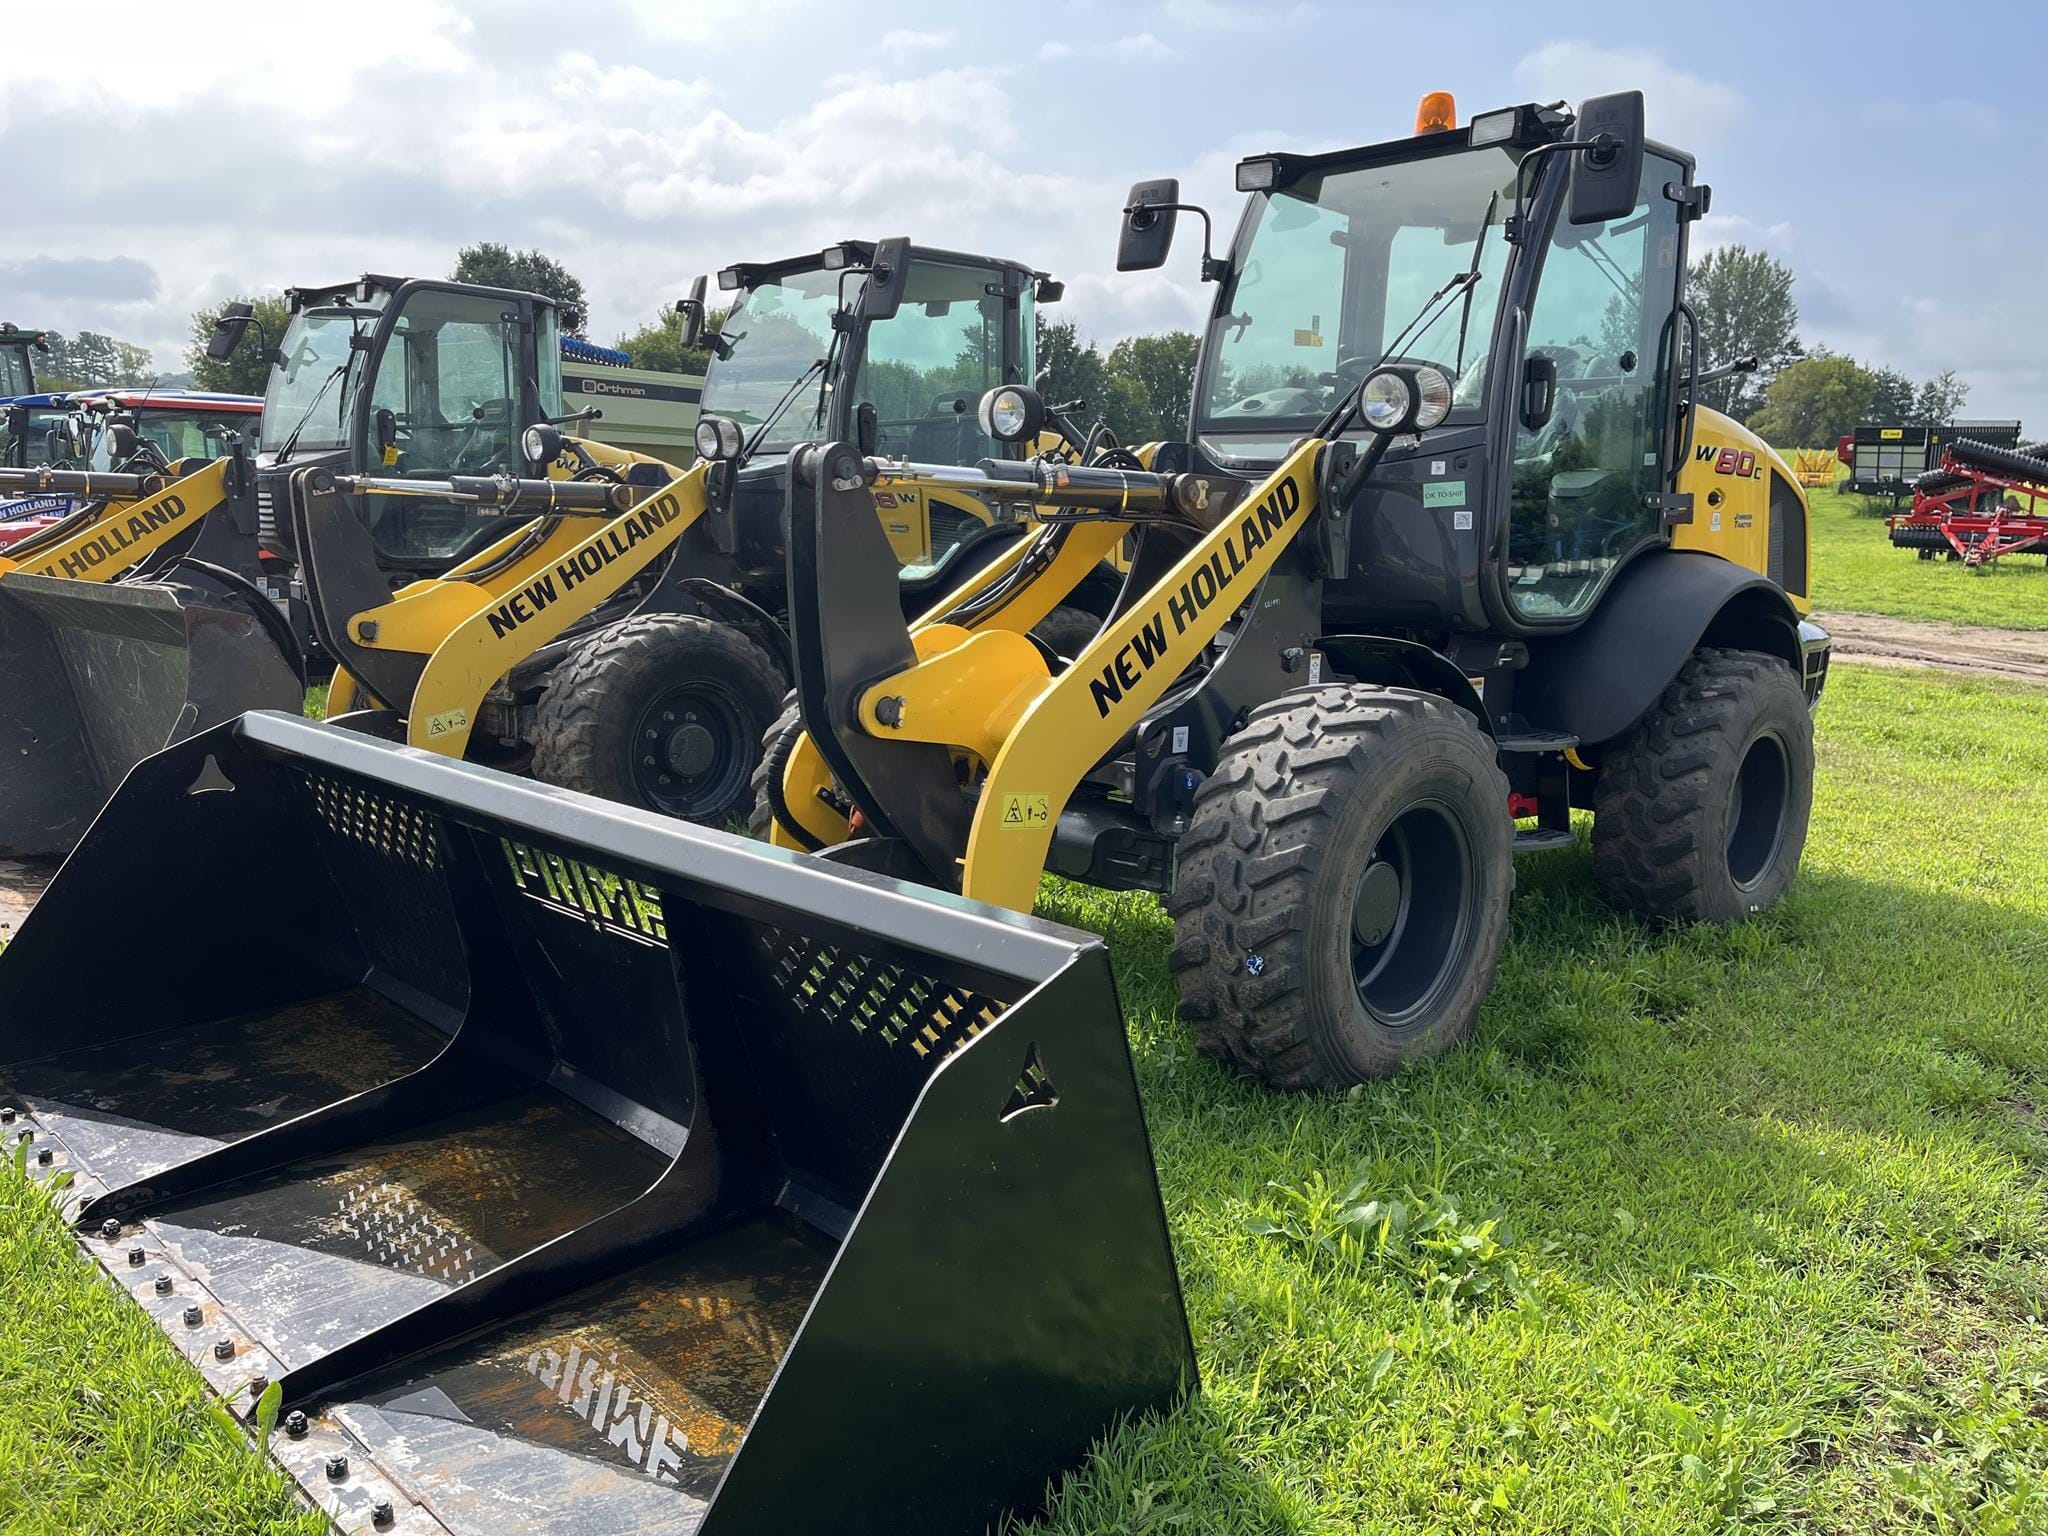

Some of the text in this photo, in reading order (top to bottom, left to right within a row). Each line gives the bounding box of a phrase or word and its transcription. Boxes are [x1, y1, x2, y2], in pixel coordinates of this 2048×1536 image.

[597, 383, 646, 396] Orthman
[8, 499, 57, 516] HOLLAND
[58, 494, 187, 579] HOLLAND
[486, 493, 681, 640] NEW HOLLAND
[1088, 475, 1301, 719] NEW HOLLAND
